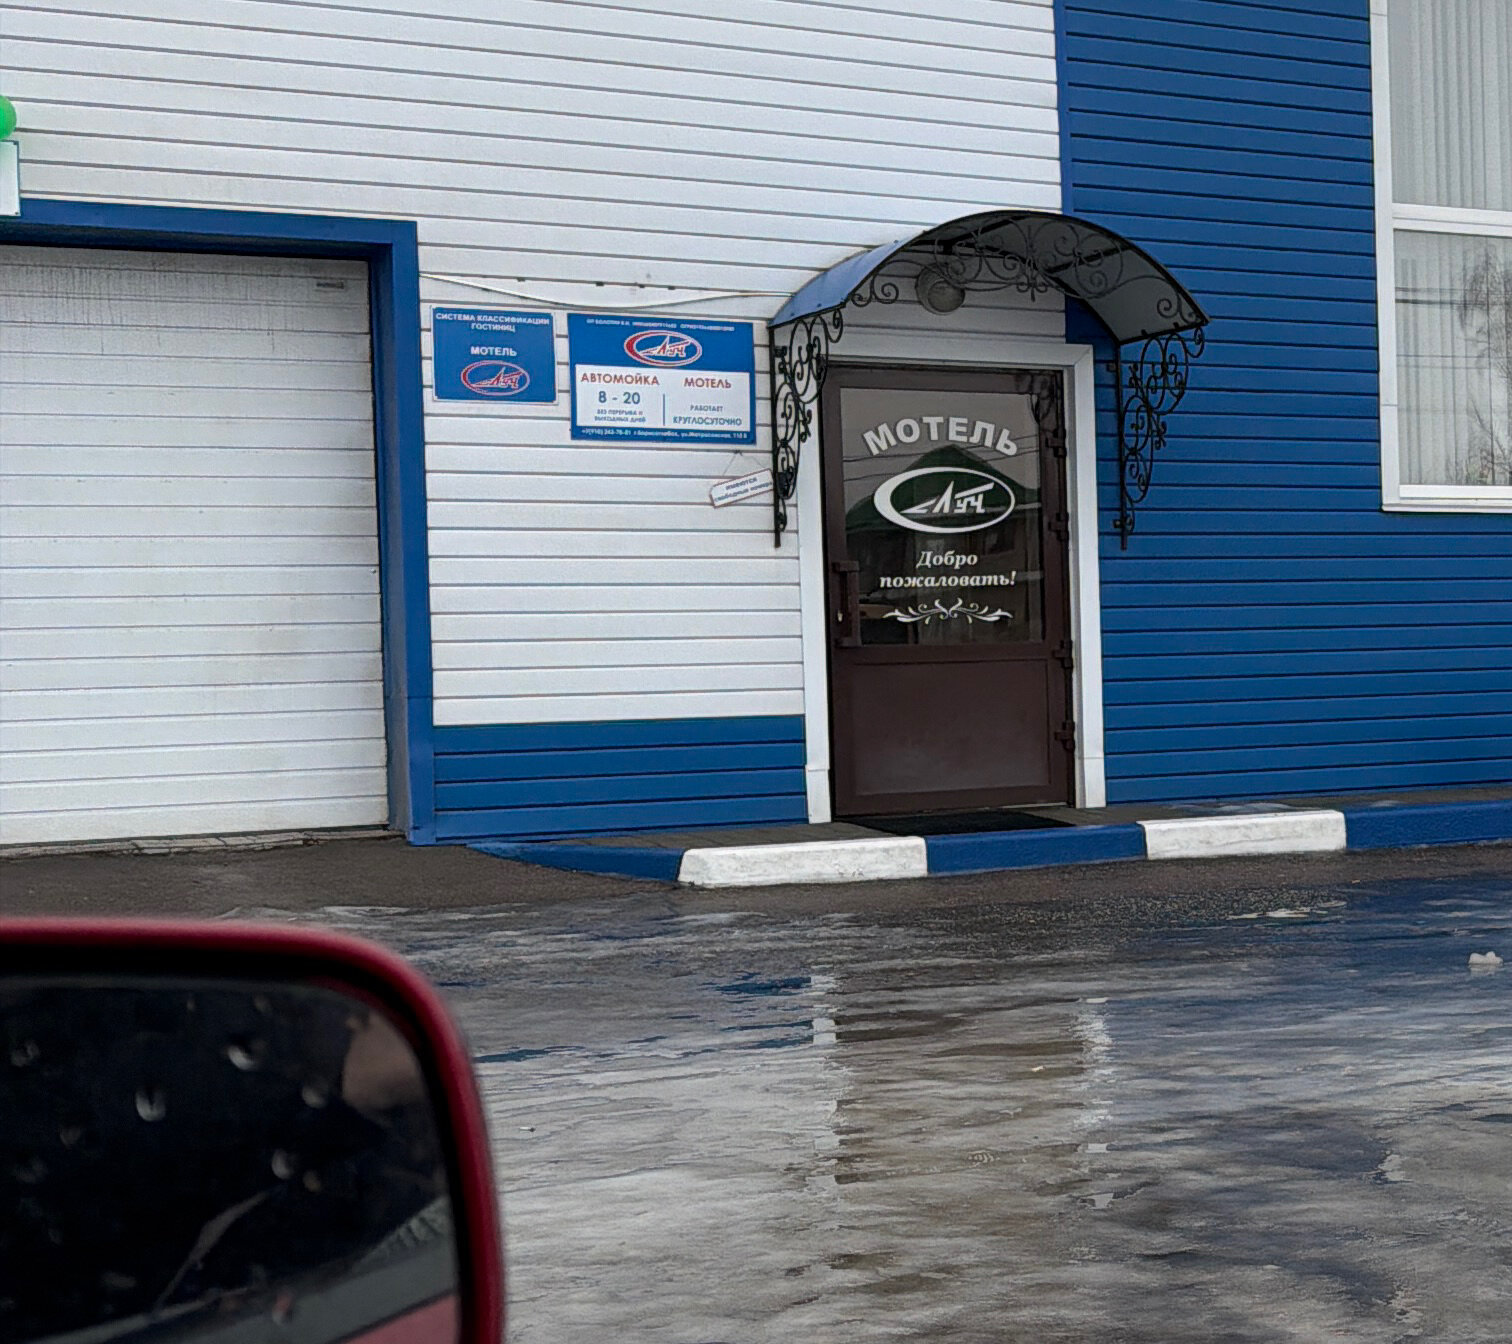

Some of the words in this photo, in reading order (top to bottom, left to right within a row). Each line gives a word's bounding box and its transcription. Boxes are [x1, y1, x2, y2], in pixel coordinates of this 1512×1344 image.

[436, 312, 475, 321] СИСТЕМА
[477, 314, 550, 325] КЛАССИФИКАЦИИ
[471, 323, 515, 332] ГОСТИНИЦ
[470, 346, 517, 356] МОТЕЛЬ
[580, 372, 660, 385] АВТОМОЙКА
[684, 377, 731, 388] МОТЕЛЬ
[598, 390, 607, 403] 8
[623, 391, 640, 404] 20
[690, 404, 723, 412] РАБОТАЕТ
[673, 416, 742, 426] КРУГЛОСУТОЧНО
[863, 416, 1018, 456] МОТЕЛЬ
[916, 550, 978, 569] Добро
[879, 570, 1017, 588] пожаловать!
